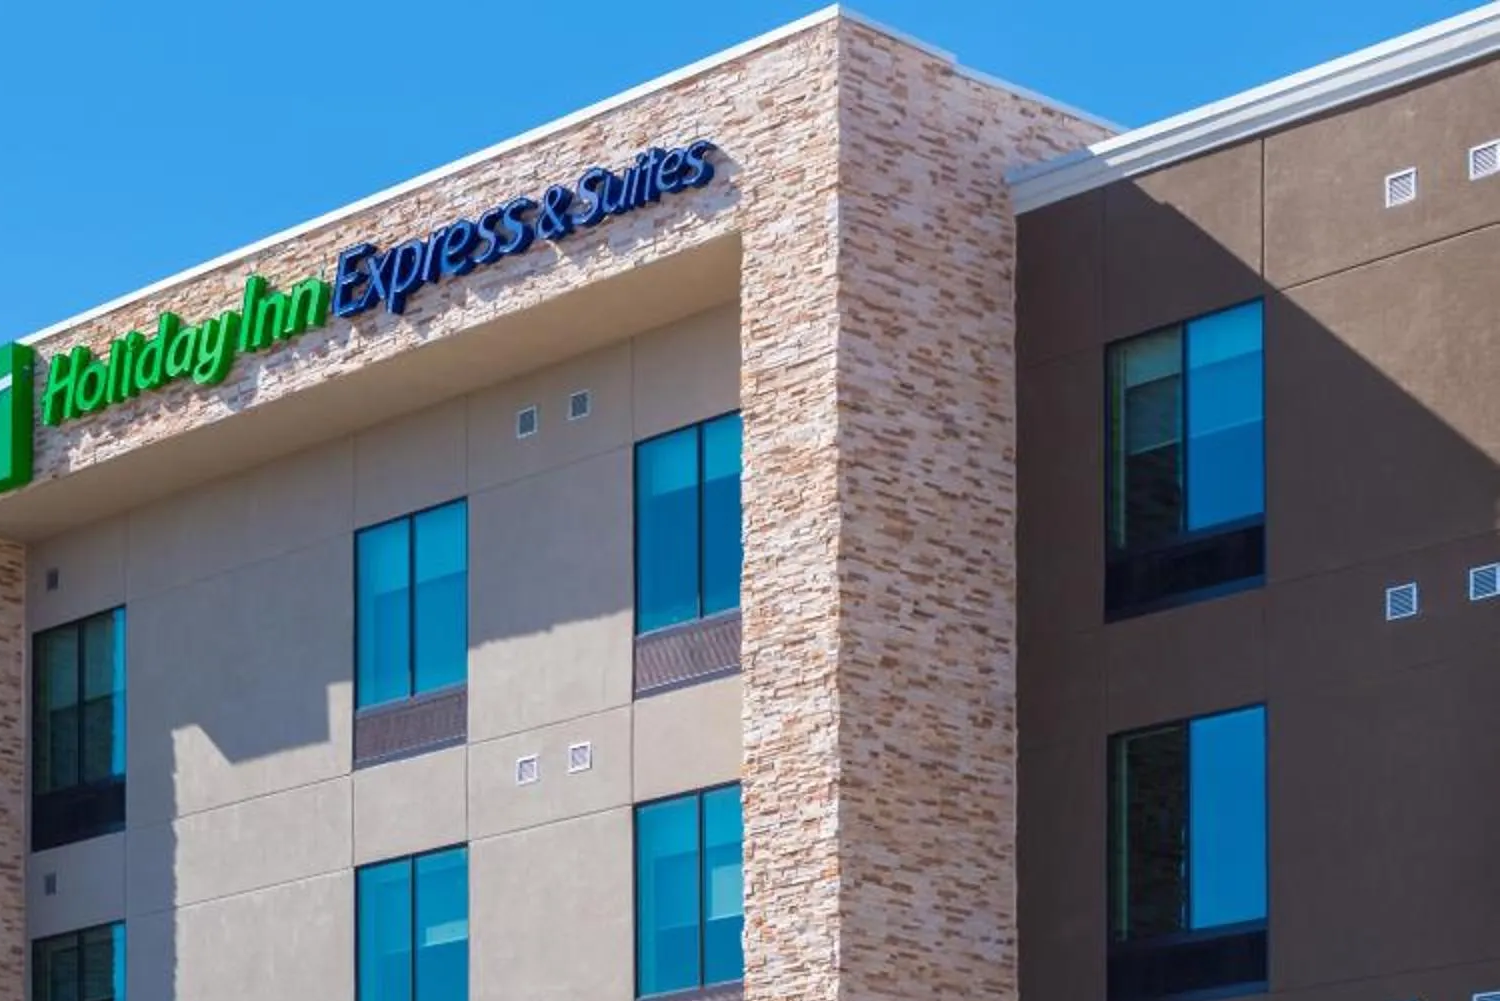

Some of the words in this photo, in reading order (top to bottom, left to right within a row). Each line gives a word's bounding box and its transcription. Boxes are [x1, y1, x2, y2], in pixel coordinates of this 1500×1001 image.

[42, 311, 240, 426] Holiday
[239, 274, 330, 352] Inn
[332, 196, 536, 317] Express
[534, 184, 575, 240] &
[572, 139, 715, 227] Suites
